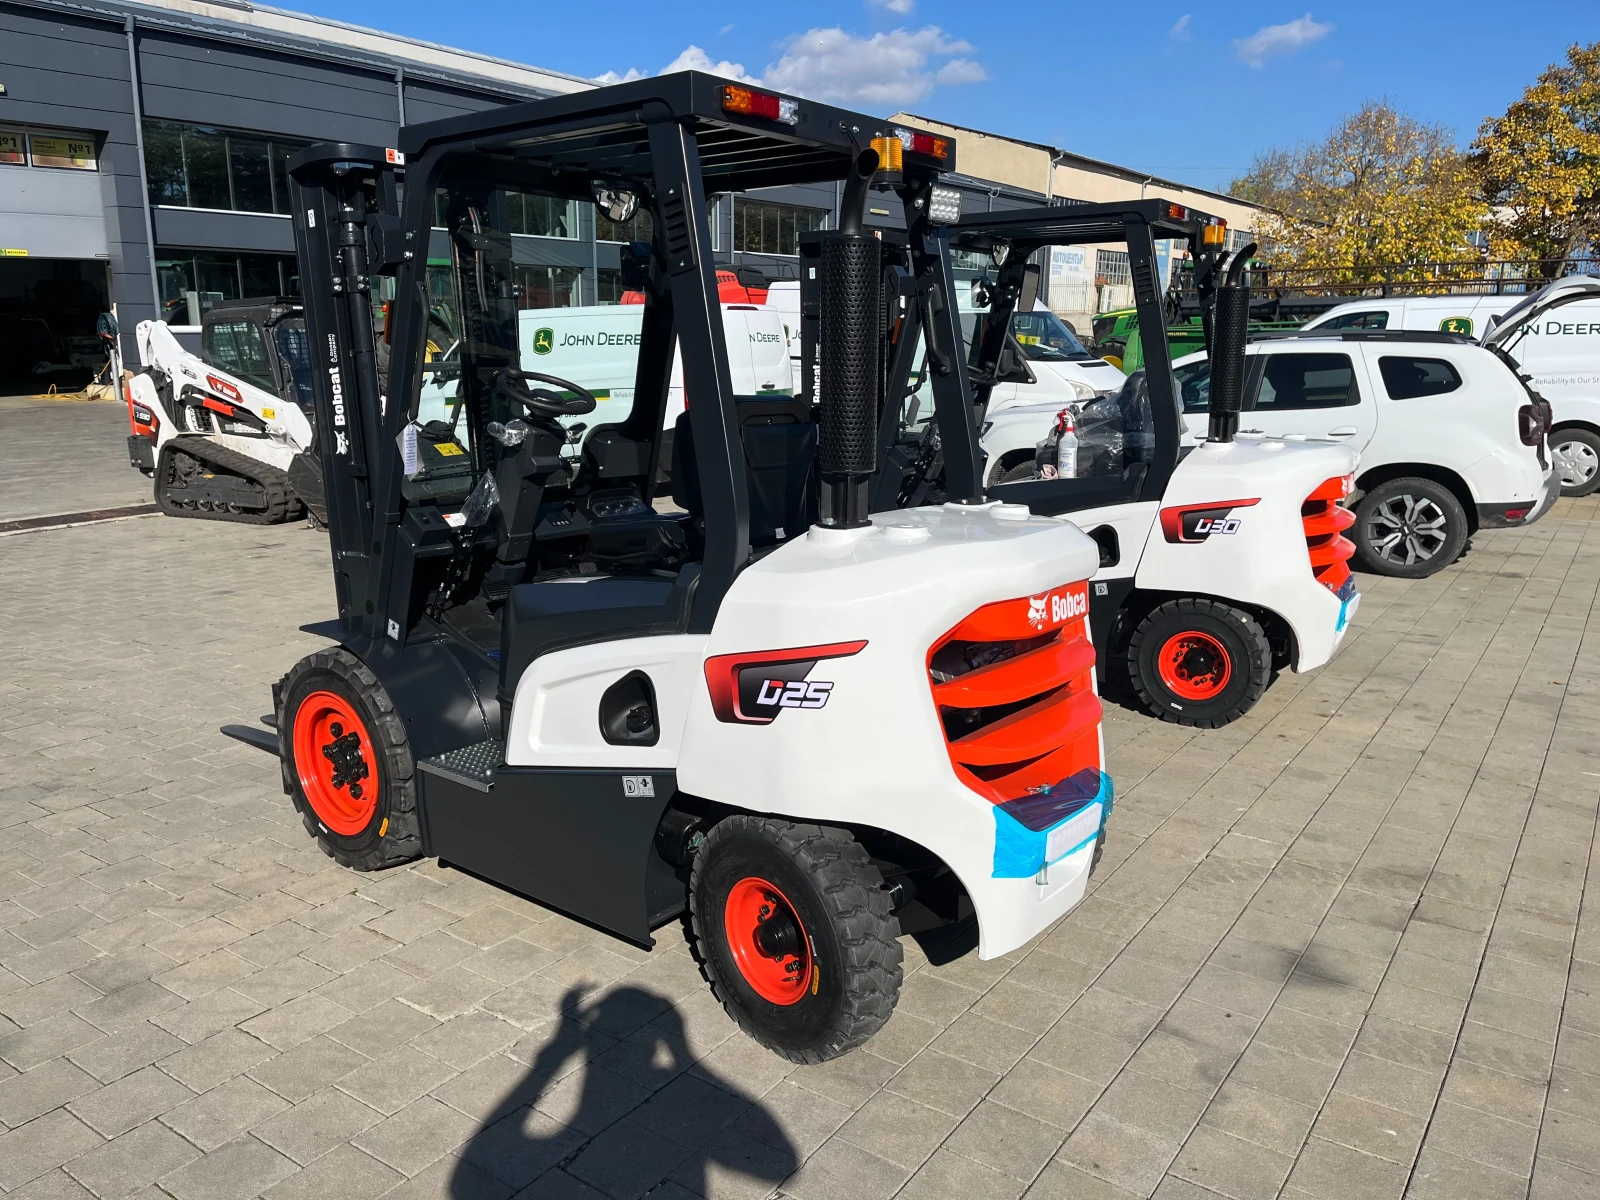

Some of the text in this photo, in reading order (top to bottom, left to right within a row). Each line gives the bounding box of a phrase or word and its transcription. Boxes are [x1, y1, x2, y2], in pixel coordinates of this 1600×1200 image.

[1545, 321, 1600, 336] DEER
[560, 332, 642, 346] JOHN DEERE
[756, 332, 780, 343] DEERE
[1535, 377, 1569, 386] Reliability
[1577, 376, 1591, 384] Our
[328, 366, 346, 426] Bobcat
[613, 391, 634, 399] Reliabilit
[1194, 518, 1241, 535] D30
[1051, 591, 1087, 623] Bobca
[756, 679, 835, 709] D25
